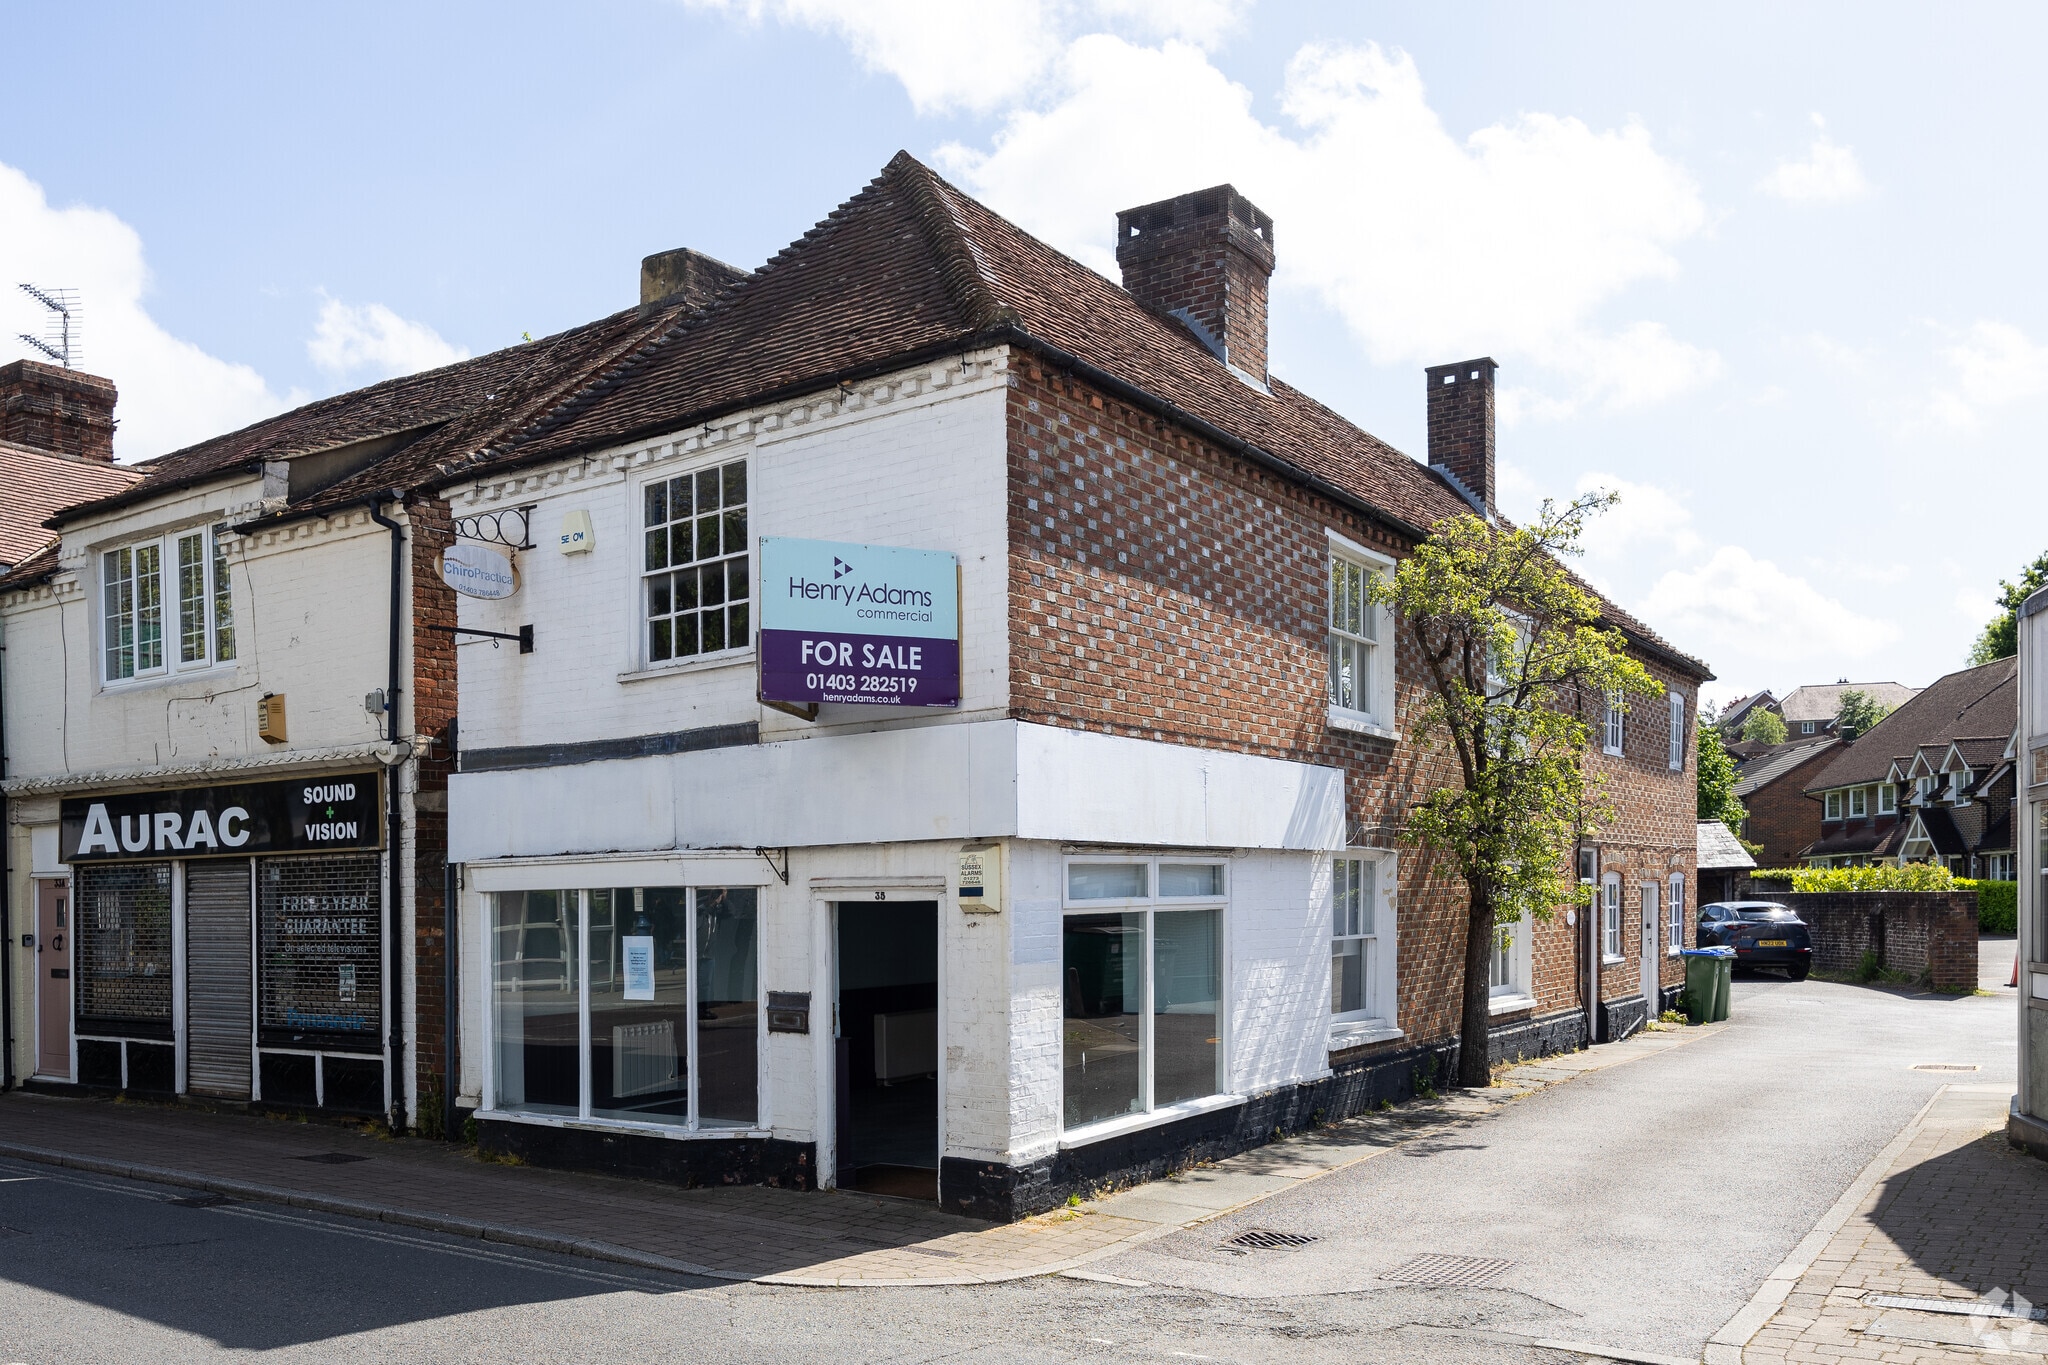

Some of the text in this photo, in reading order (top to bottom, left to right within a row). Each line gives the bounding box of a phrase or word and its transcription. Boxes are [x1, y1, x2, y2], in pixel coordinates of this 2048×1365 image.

[561, 531, 584, 544] SEOM
[443, 562, 515, 586] ChiroPractical
[458, 583, 477, 596] 01403
[789, 576, 932, 607] Henry Adams
[857, 608, 933, 623] commercial
[801, 640, 922, 671] FOR SALE
[806, 673, 918, 693] 01403 282519
[823, 692, 901, 704] henryadams.co.uk
[303, 783, 356, 805] SOUND
[305, 821, 358, 841] VISION
[285, 917, 368, 934] GUARANTEE
